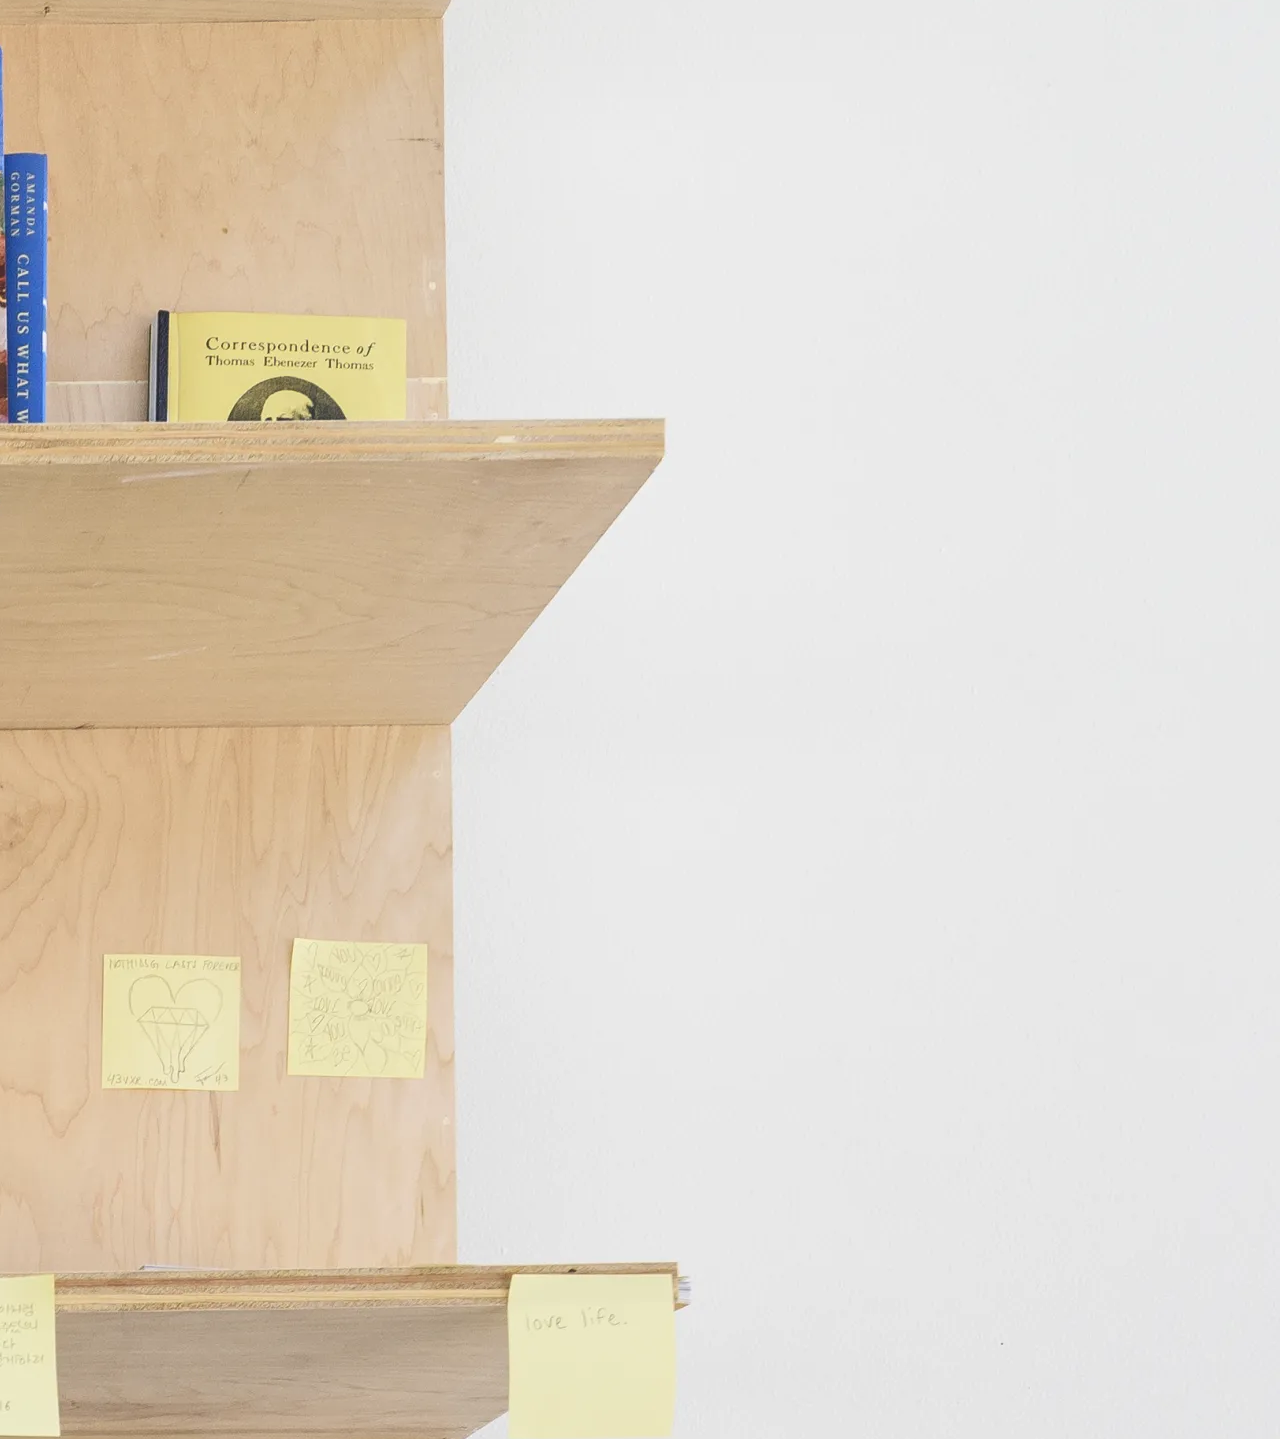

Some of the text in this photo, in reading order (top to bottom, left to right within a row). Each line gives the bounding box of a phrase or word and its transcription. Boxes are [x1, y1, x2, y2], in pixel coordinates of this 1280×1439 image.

[11, 171, 19, 238] GORMAN
[24, 172, 34, 236] AMANDA
[15, 254, 30, 302] CALL
[16, 311, 29, 334] US
[205, 356, 374, 371] Thomas Ebenezer Thomas
[206, 337, 376, 357] Correspondence of
[16, 345, 30, 399] WHAT
